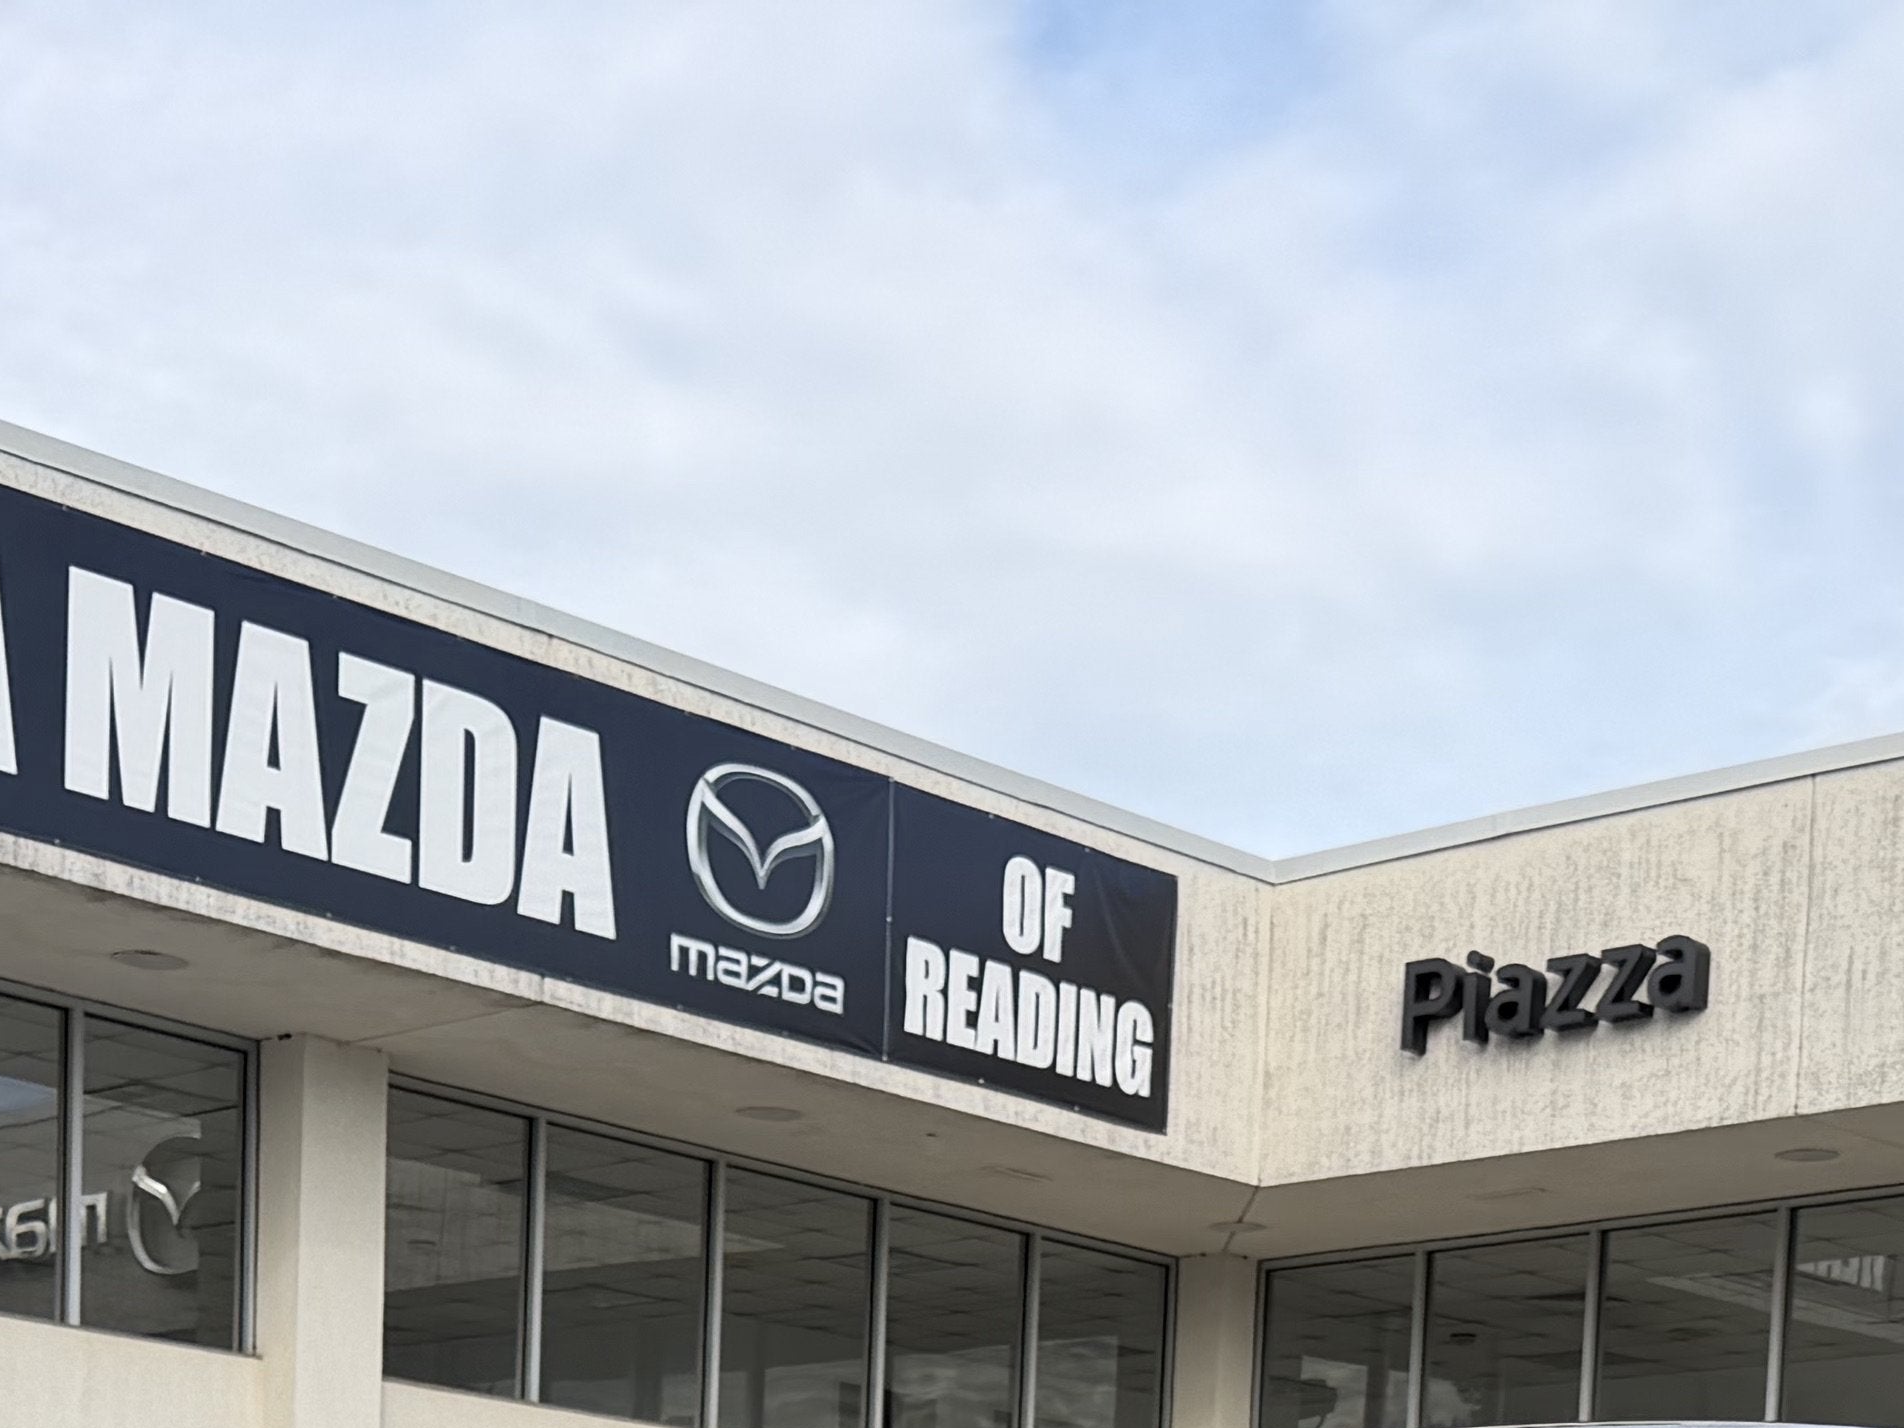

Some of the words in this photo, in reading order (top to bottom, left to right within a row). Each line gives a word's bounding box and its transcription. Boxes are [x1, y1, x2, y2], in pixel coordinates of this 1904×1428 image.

[65, 564, 618, 940] MAZDA
[1002, 855, 1075, 963] OF
[670, 933, 845, 1016] mazda
[904, 935, 1156, 1098] READING
[1400, 934, 1711, 1056] Piazza
